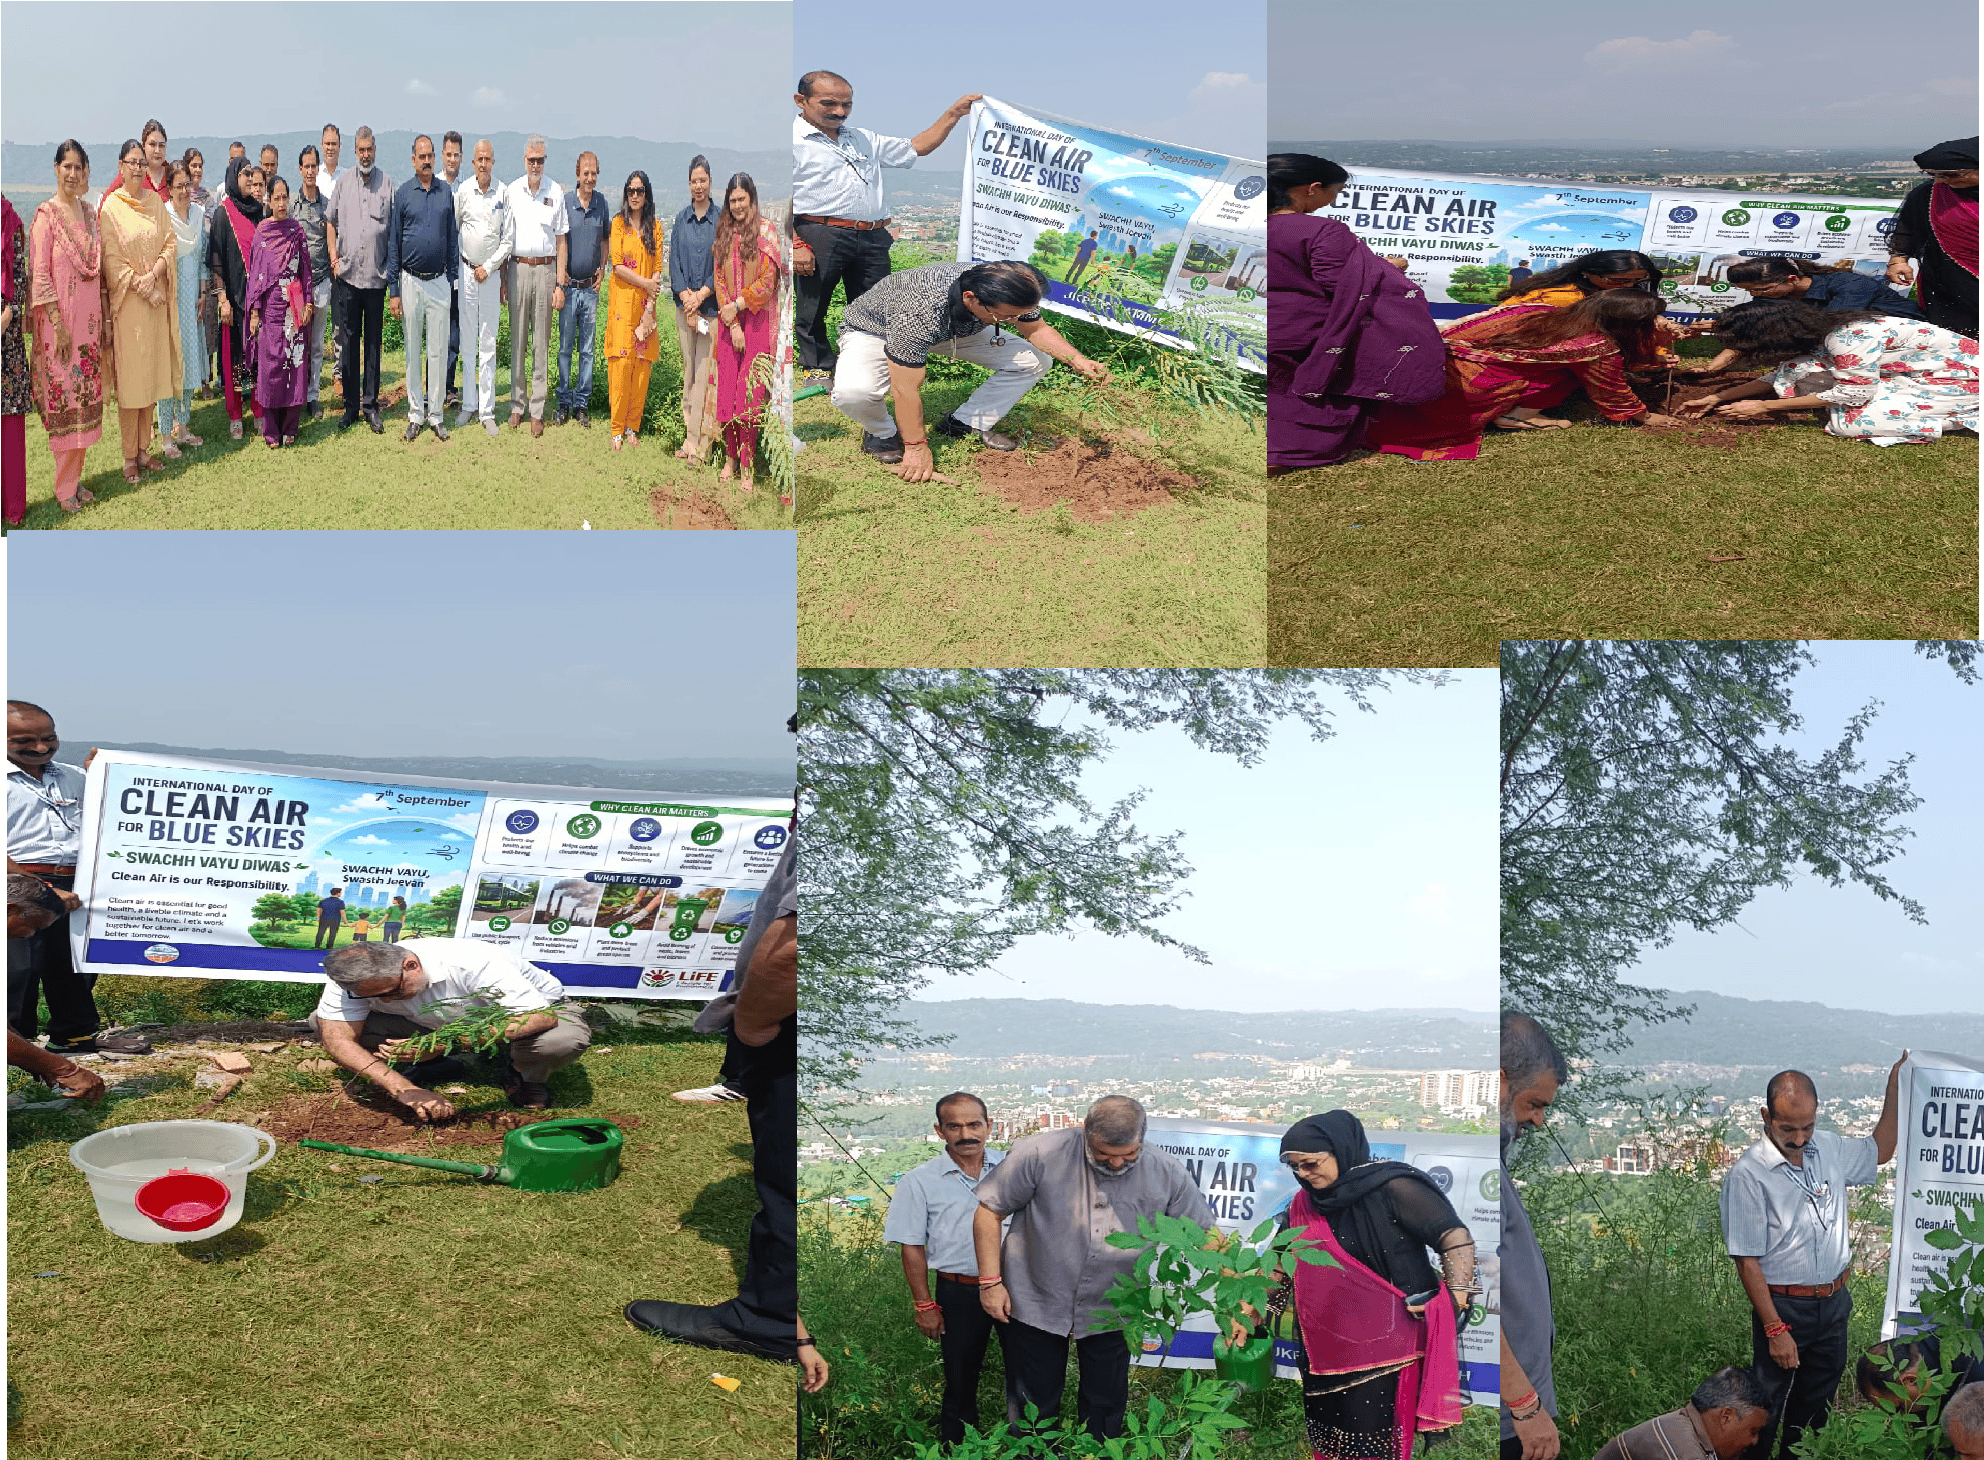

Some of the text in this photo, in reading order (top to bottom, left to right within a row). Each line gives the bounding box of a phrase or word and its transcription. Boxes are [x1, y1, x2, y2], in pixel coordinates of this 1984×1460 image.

[994, 121, 1076, 144] INTERNATIONAL DAY OF
[982, 130, 1093, 174] CLEAN AIR
[1159, 152, 1216, 170] September
[977, 157, 1080, 193] FOR BLUE SKIES
[976, 183, 1071, 213] SWACHH VAYU DIWAS
[1345, 184, 1424, 194] NTERNATIONAL
[1330, 190, 1497, 218] CLEAN AIR
[1574, 195, 1638, 205] September
[985, 203, 994, 212] Air
[995, 206, 1000, 214] is
[1001, 208, 1012, 216] our
[1013, 210, 1064, 229] Responsibility.
[1099, 212, 1131, 225] SWACHH
[1355, 213, 1417, 231] BLUE
[1425, 217, 1495, 235] SKIES
[1361, 236, 1484, 251] ACHH VAYU DIWAS
[1408, 252, 1484, 264] Responsibility.
[133, 777, 274, 796] INTERNATIONAL DAY OF
[121, 788, 309, 826] CLEAN AIR
[375, 790, 470, 807] 7th September
[600, 803, 620, 811] WHY
[669, 808, 709, 817] MATTERS
[118, 820, 305, 850] FOR BLUE SKIES
[126, 851, 290, 873] SWACHH VAYU DIWAS
[342, 865, 430, 878] SWACHH VAYU,
[343, 875, 383, 884] Swasth
[623, 876, 637, 884] WE
[111, 871, 290, 892] Clean Air is our Responsibility.
[678, 972, 719, 981] LiFE
[1931, 1086, 1984, 1100] INTERNATIO
[1922, 1101, 1984, 1140] CLEA
[1198, 1147, 1216, 1157] DAY
[1218, 1149, 1230, 1157] OF
[1920, 1144, 1984, 1174] FOR BLU
[1210, 1162, 1257, 1192] AIR
[1209, 1194, 1254, 1220] KIES
[1916, 1218, 1955, 1230] Clean Air
[1913, 1252, 1930, 1261] Clean
